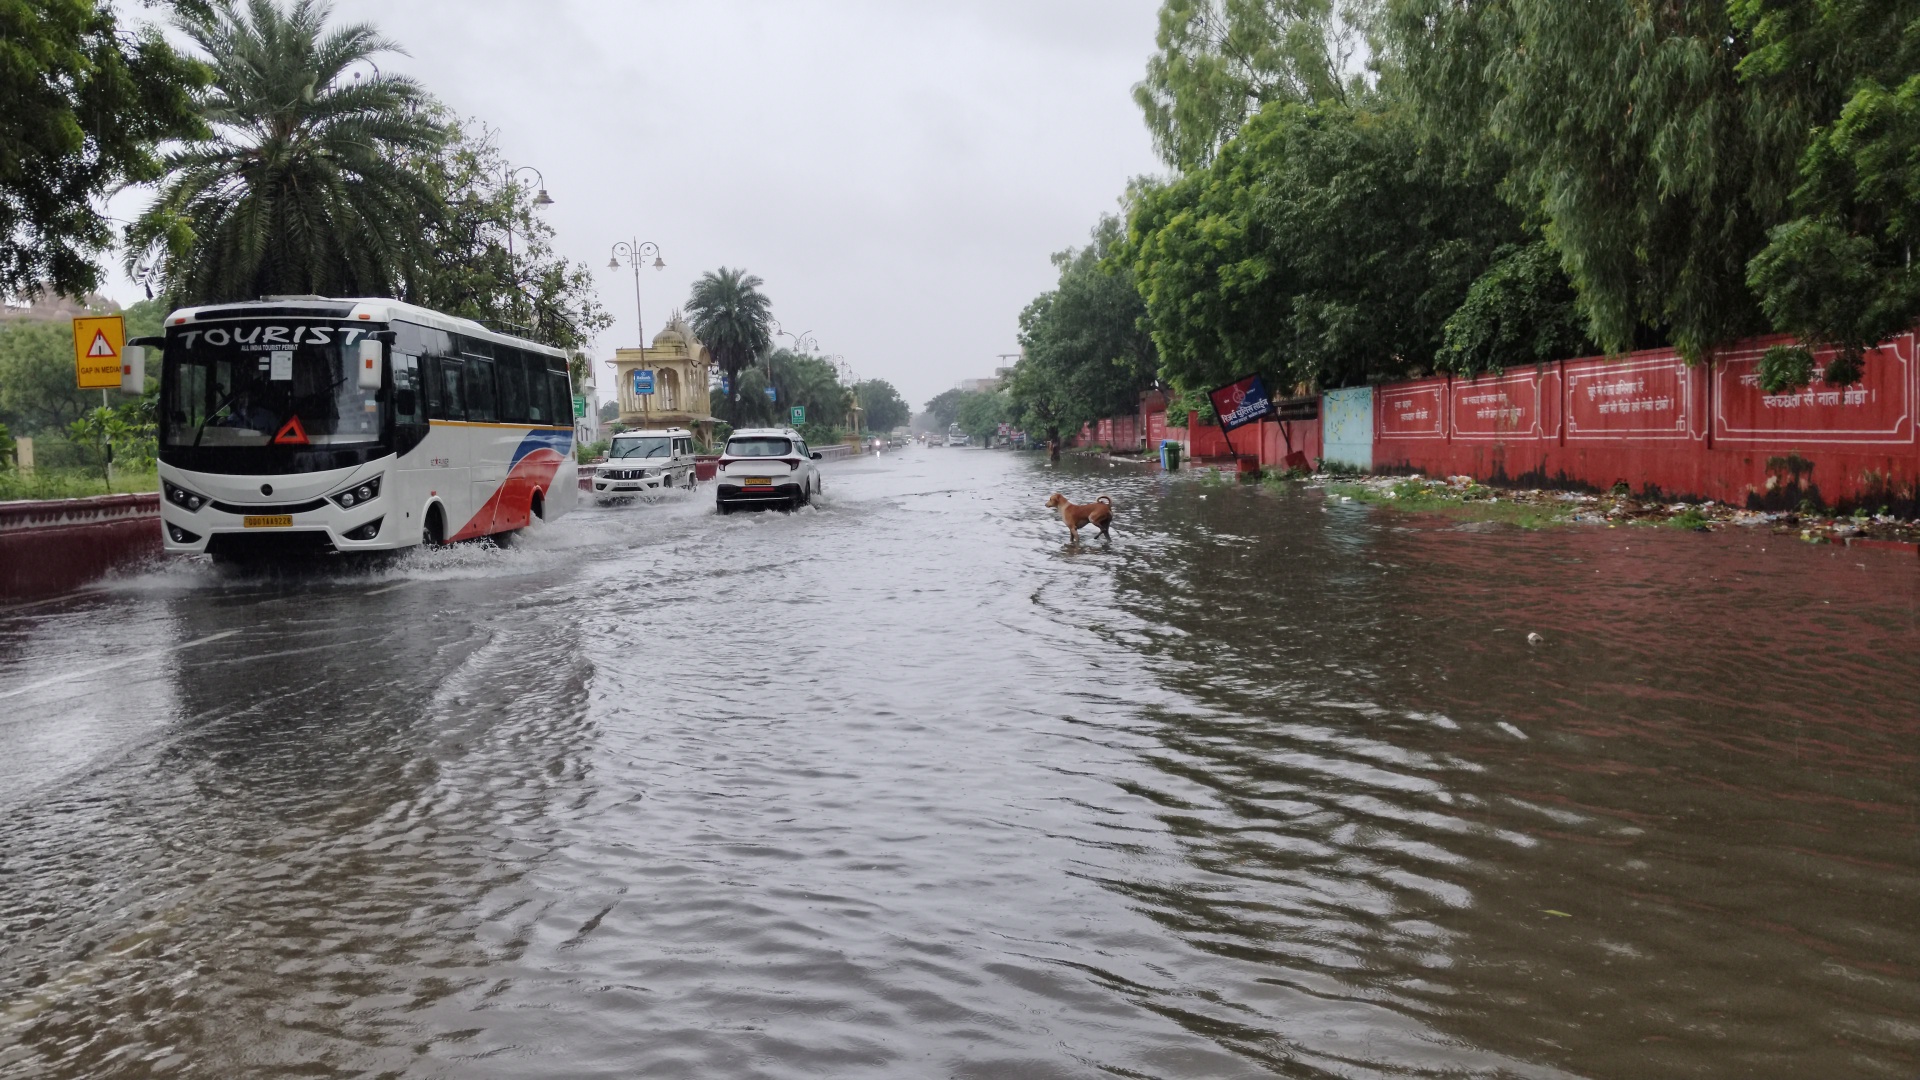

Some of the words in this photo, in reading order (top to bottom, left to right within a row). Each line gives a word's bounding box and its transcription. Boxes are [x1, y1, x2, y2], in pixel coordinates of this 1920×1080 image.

[178, 326, 366, 349] TOURIST
[81, 366, 93, 375] GAP
[94, 366, 100, 374] IN
[1762, 393, 1802, 409] स्वच्छता
[1803, 387, 1815, 407] से
[1817, 391, 1841, 407] नाता
[1236, 404, 1254, 418] पुलिस
